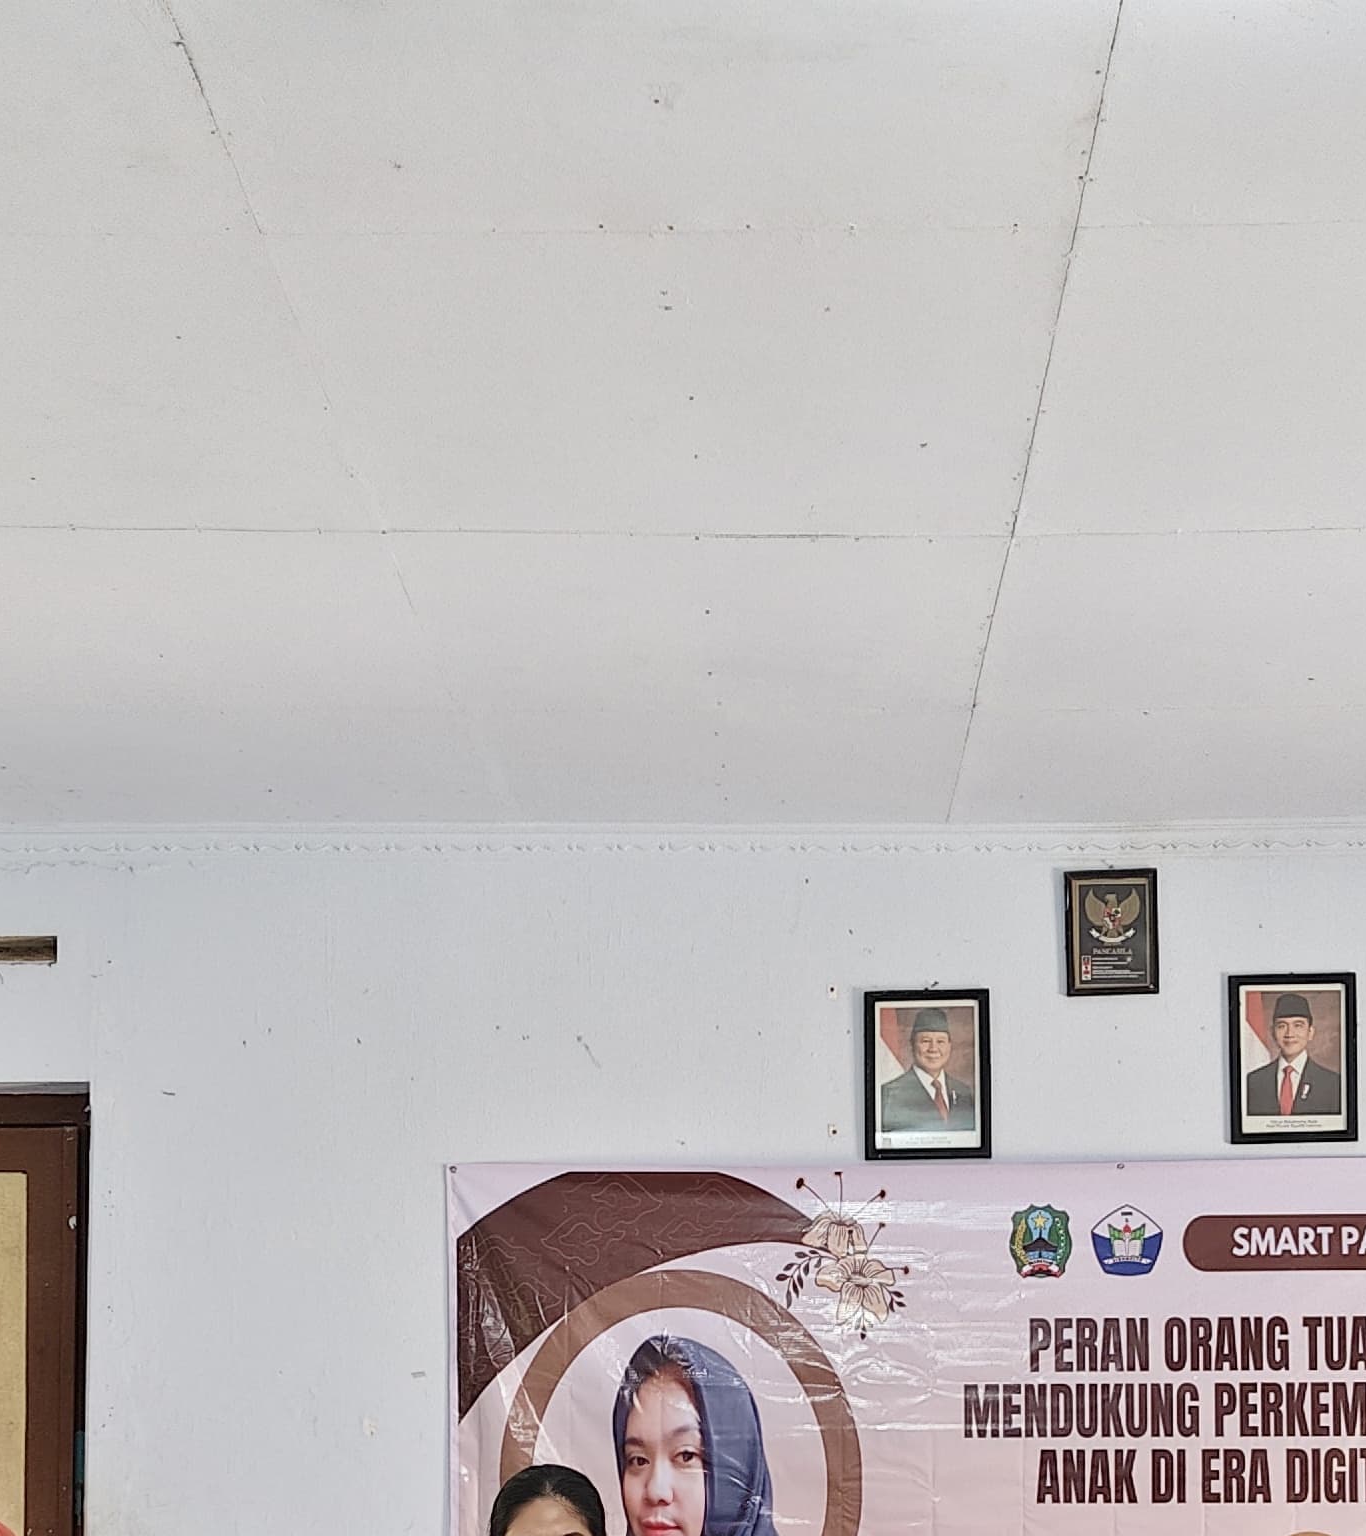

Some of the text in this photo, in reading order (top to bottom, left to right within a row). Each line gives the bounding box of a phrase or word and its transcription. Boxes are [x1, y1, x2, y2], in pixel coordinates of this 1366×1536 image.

[1232, 1225, 1332, 1257] SMART
[1029, 1317, 1149, 1372] PERAN
[1165, 1317, 1290, 1371] ORANG
[963, 1383, 1199, 1438] MENDUKUNG
[1036, 1449, 1138, 1504] ANAK
[1151, 1449, 1186, 1503] DI
[1201, 1448, 1271, 1503] ERA
